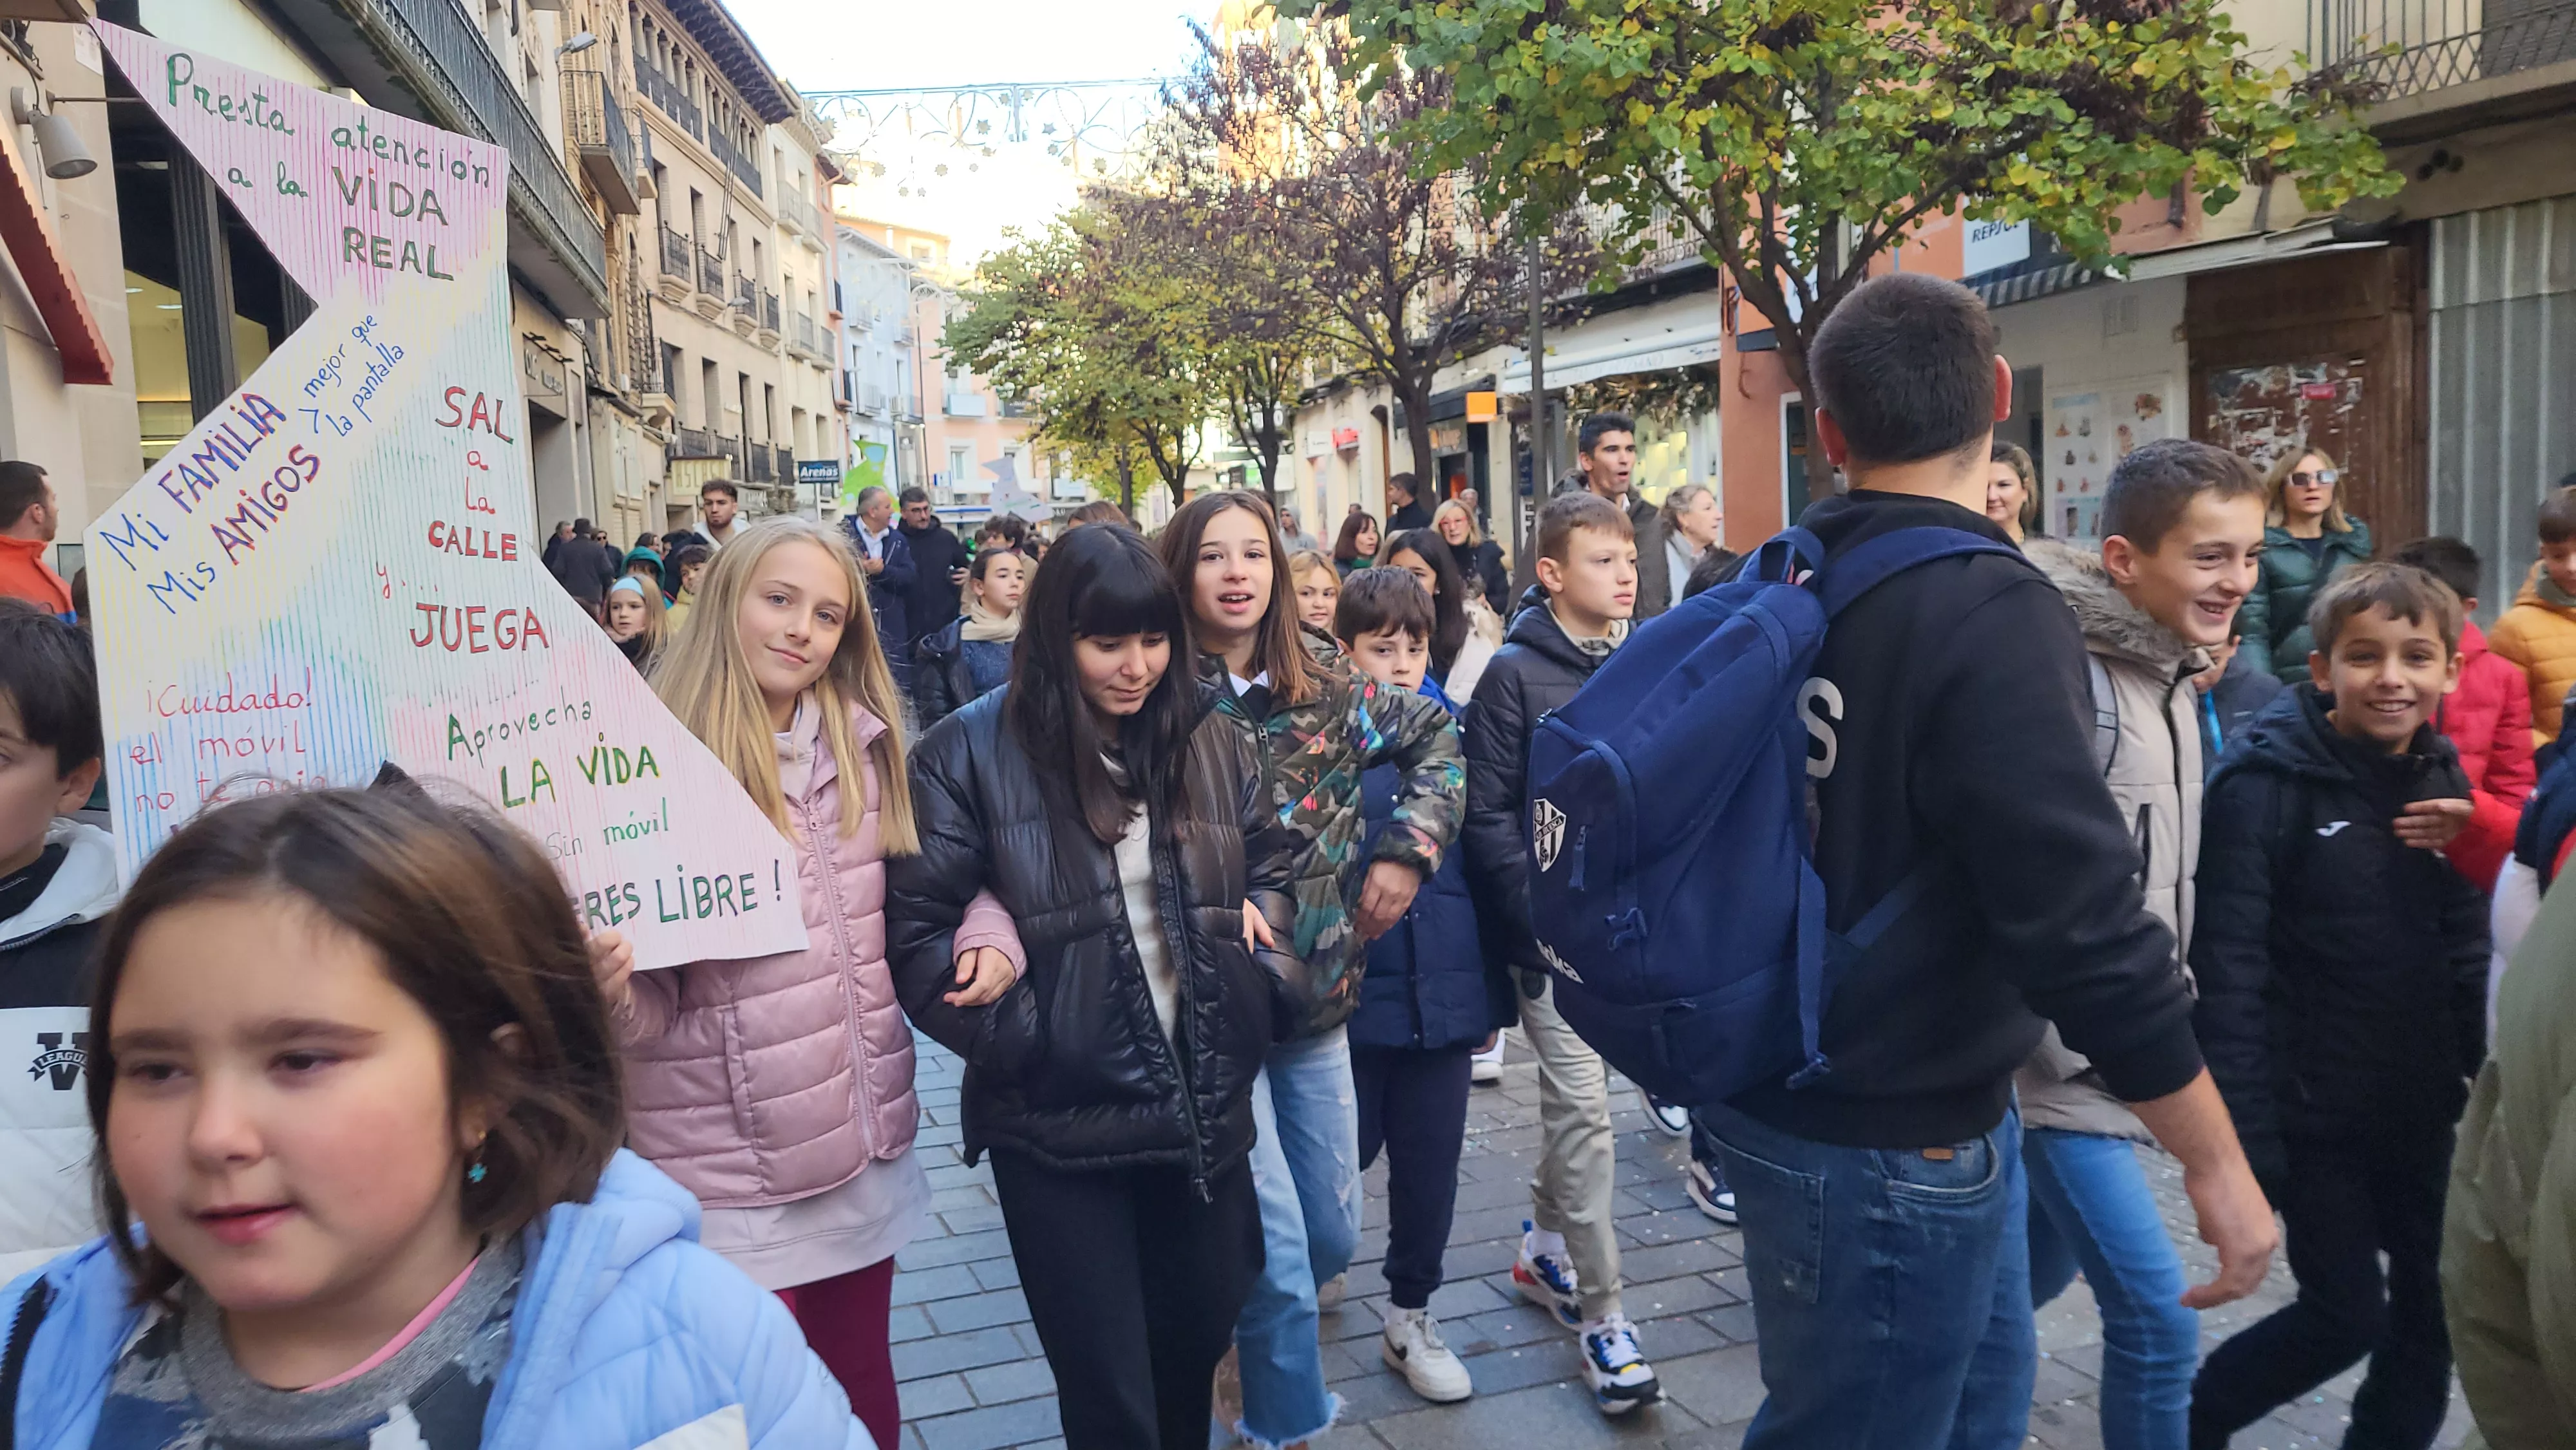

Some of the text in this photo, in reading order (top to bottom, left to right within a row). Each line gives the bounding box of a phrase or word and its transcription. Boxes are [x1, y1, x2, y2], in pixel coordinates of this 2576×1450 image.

[167, 53, 296, 136] Presta
[228, 167, 253, 188] a
[343, 226, 454, 281] REAL
[1972, 216, 2020, 243] REPSO
[304, 315, 377, 398] mejor que
[352, 343, 404, 423] pantalla
[435, 386, 514, 445] SAL
[467, 451, 489, 471] a
[800, 466, 839, 478] Arenas
[99, 513, 169, 571] Mi
[428, 520, 517, 561] CALLE
[147, 561, 216, 614] Mis
[410, 602, 550, 654] JUEGA
[130, 732, 164, 764] el
[448, 686, 591, 767] Aprovecha
[1797, 677, 1844, 778] S
[136, 792, 175, 812] no
[500, 758, 556, 811] LA
[603, 797, 668, 845] móvil
